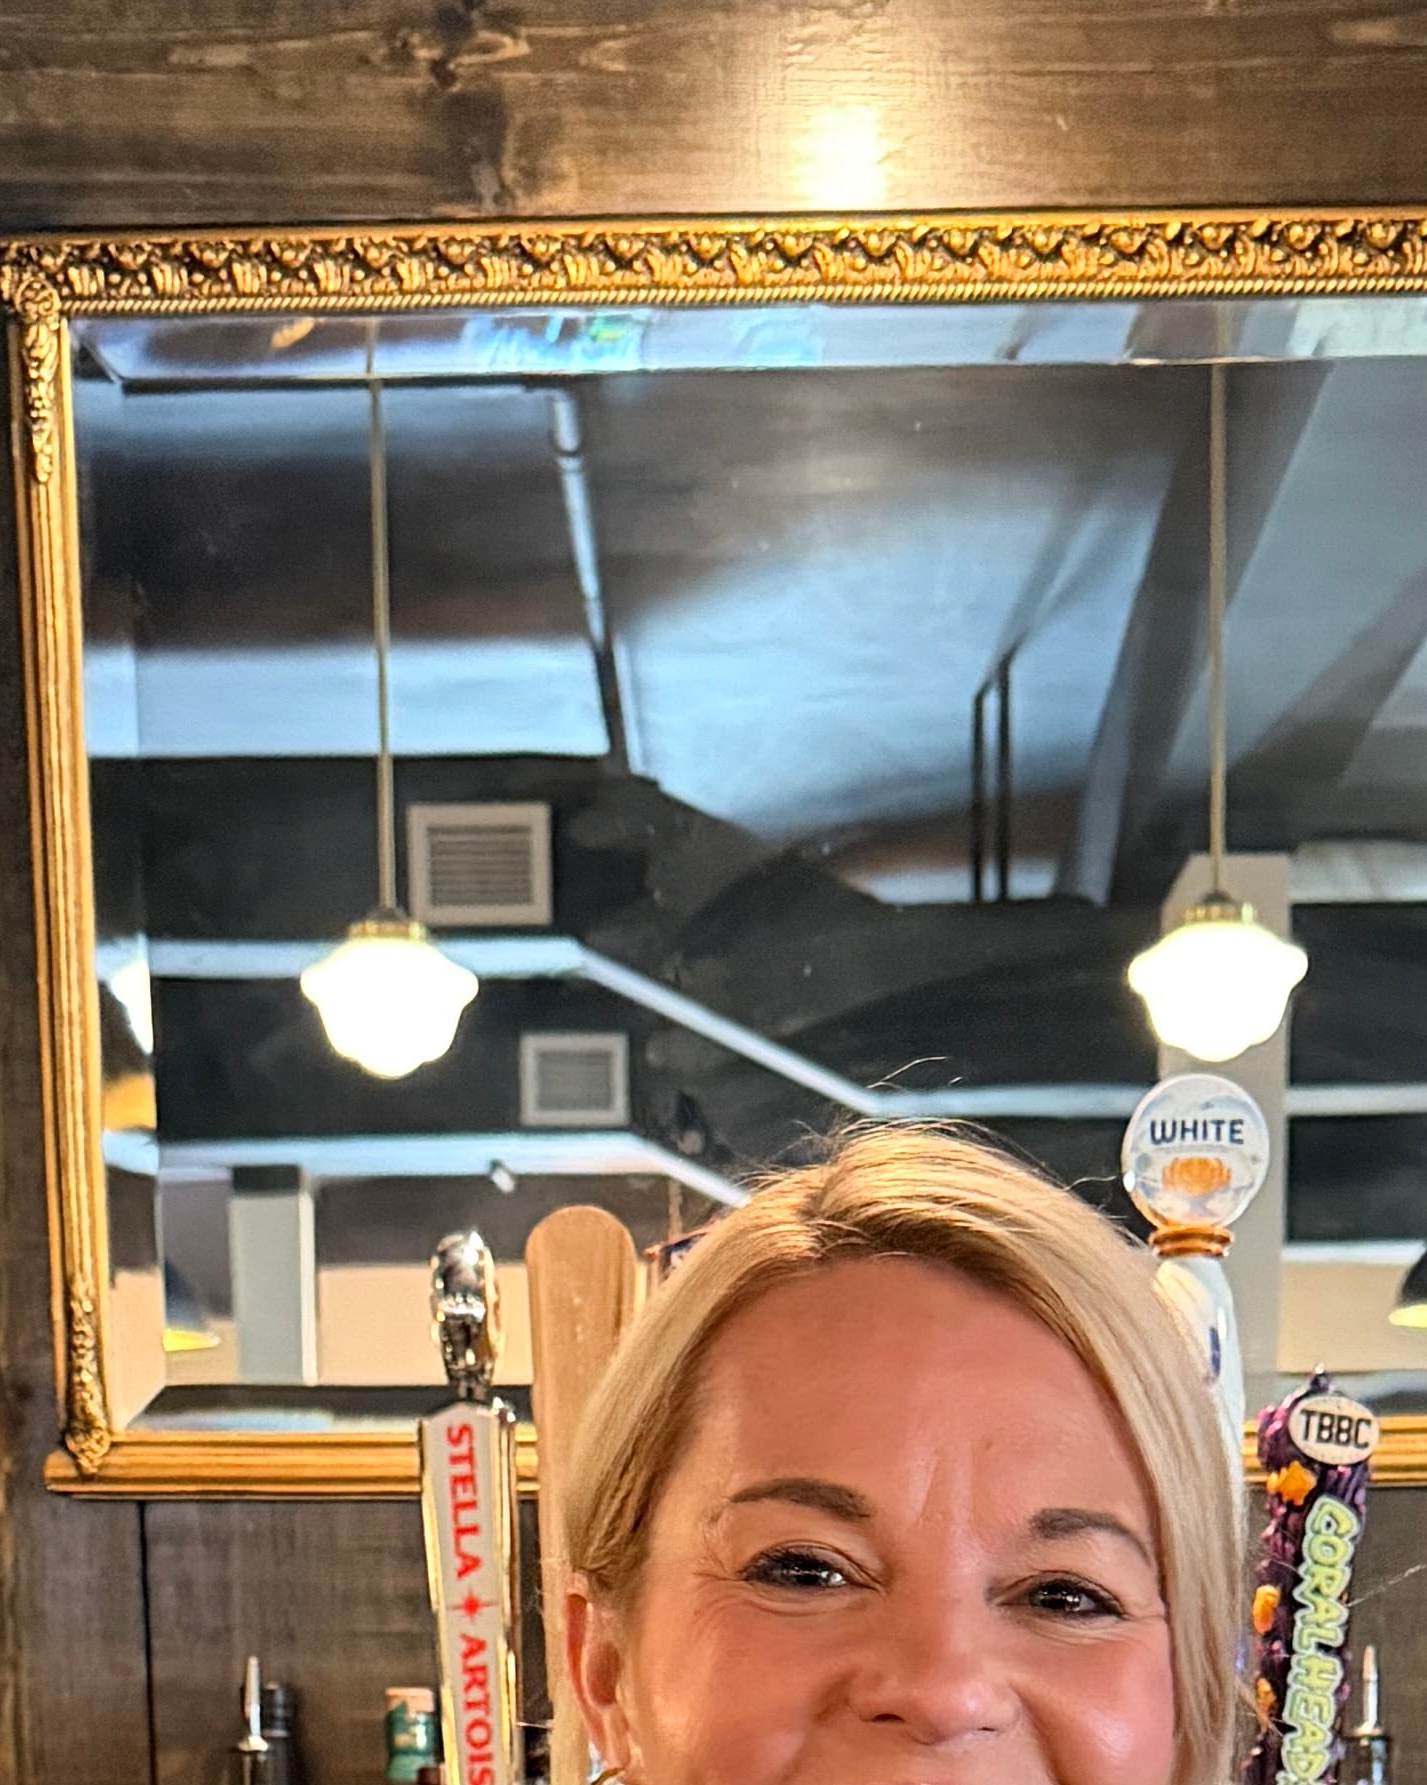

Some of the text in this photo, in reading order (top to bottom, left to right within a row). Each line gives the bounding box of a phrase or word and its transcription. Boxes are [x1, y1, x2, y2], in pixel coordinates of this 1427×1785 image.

[1150, 1118, 1245, 1145] WHITE
[1300, 1408, 1372, 1450] TBBC
[446, 1422, 482, 1579] STELLA
[1293, 1494, 1359, 1654] CORAL
